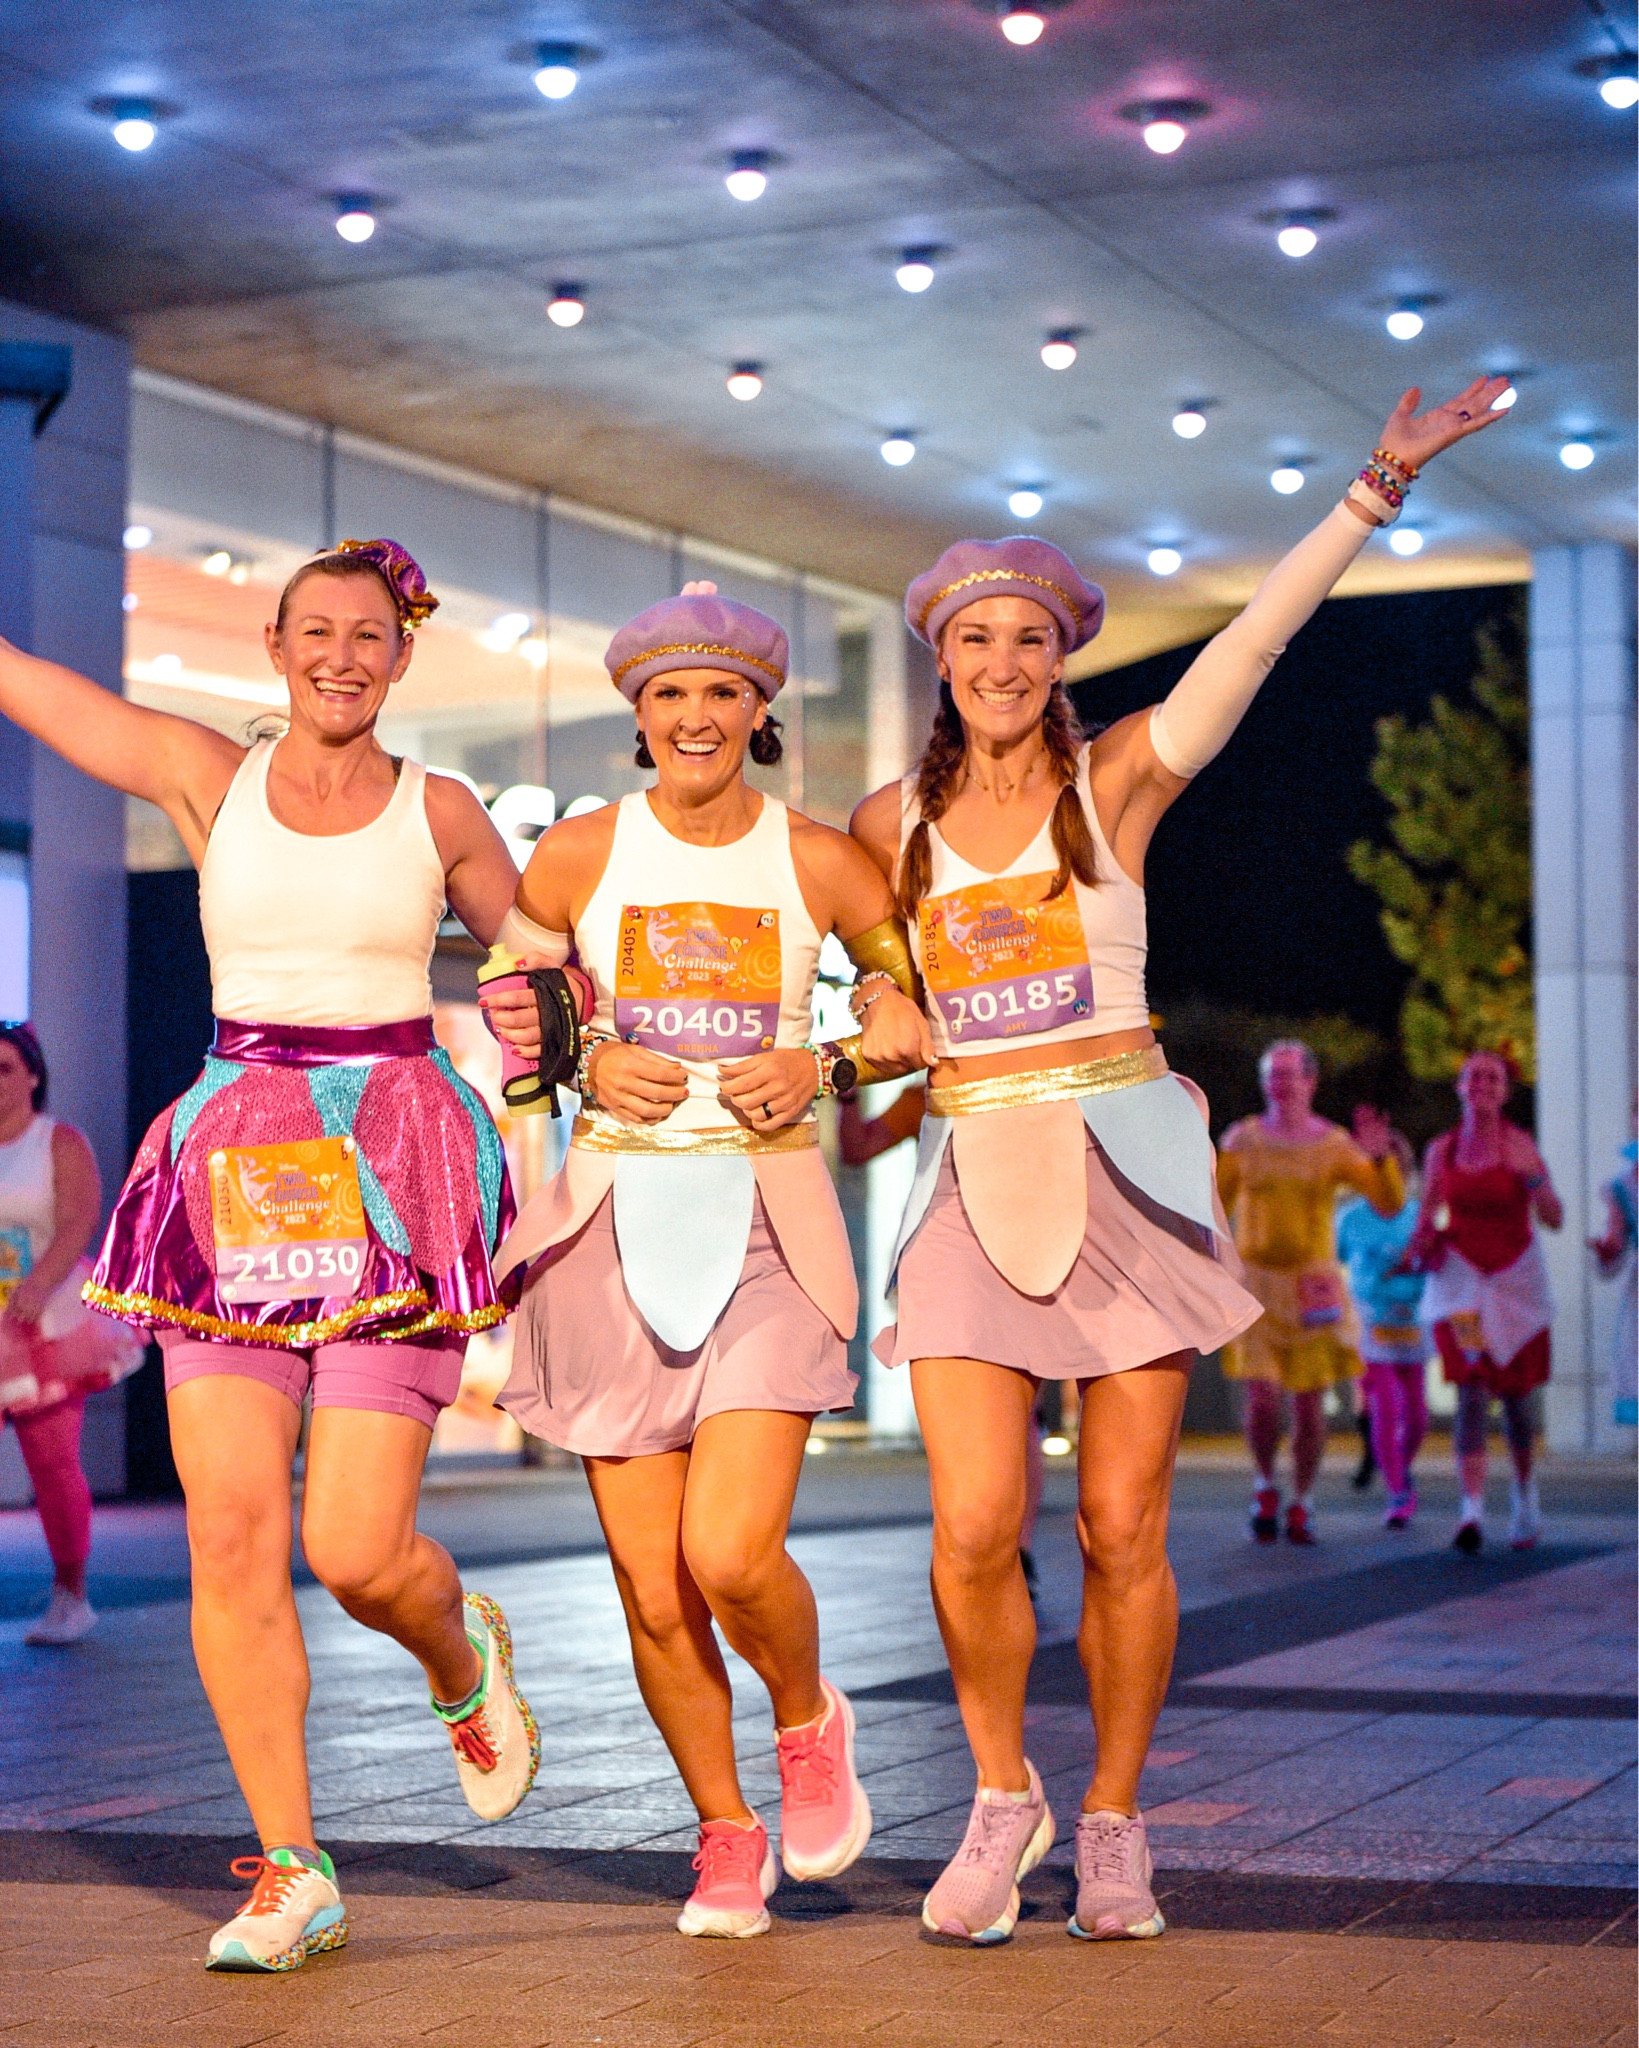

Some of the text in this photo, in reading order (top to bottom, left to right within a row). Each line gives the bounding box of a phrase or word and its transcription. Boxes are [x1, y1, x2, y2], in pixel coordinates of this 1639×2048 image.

[979, 907, 1012, 925] TWO
[685, 929, 718, 943] TWO
[973, 920, 1026, 942] COURSE
[622, 927, 637, 976] 20405
[925, 922, 940, 971] 20185
[966, 934, 1038, 955] Challenge
[664, 954, 737, 974] Challenge
[687, 971, 710, 981] 2023
[948, 974, 1077, 1025] 20185
[632, 1006, 763, 1038] 20405
[1005, 1021, 1027, 1033] AMY
[217, 1175, 232, 1225] 21030
[260, 1200, 331, 1216] Challenge
[233, 1245, 359, 1283] 21030
